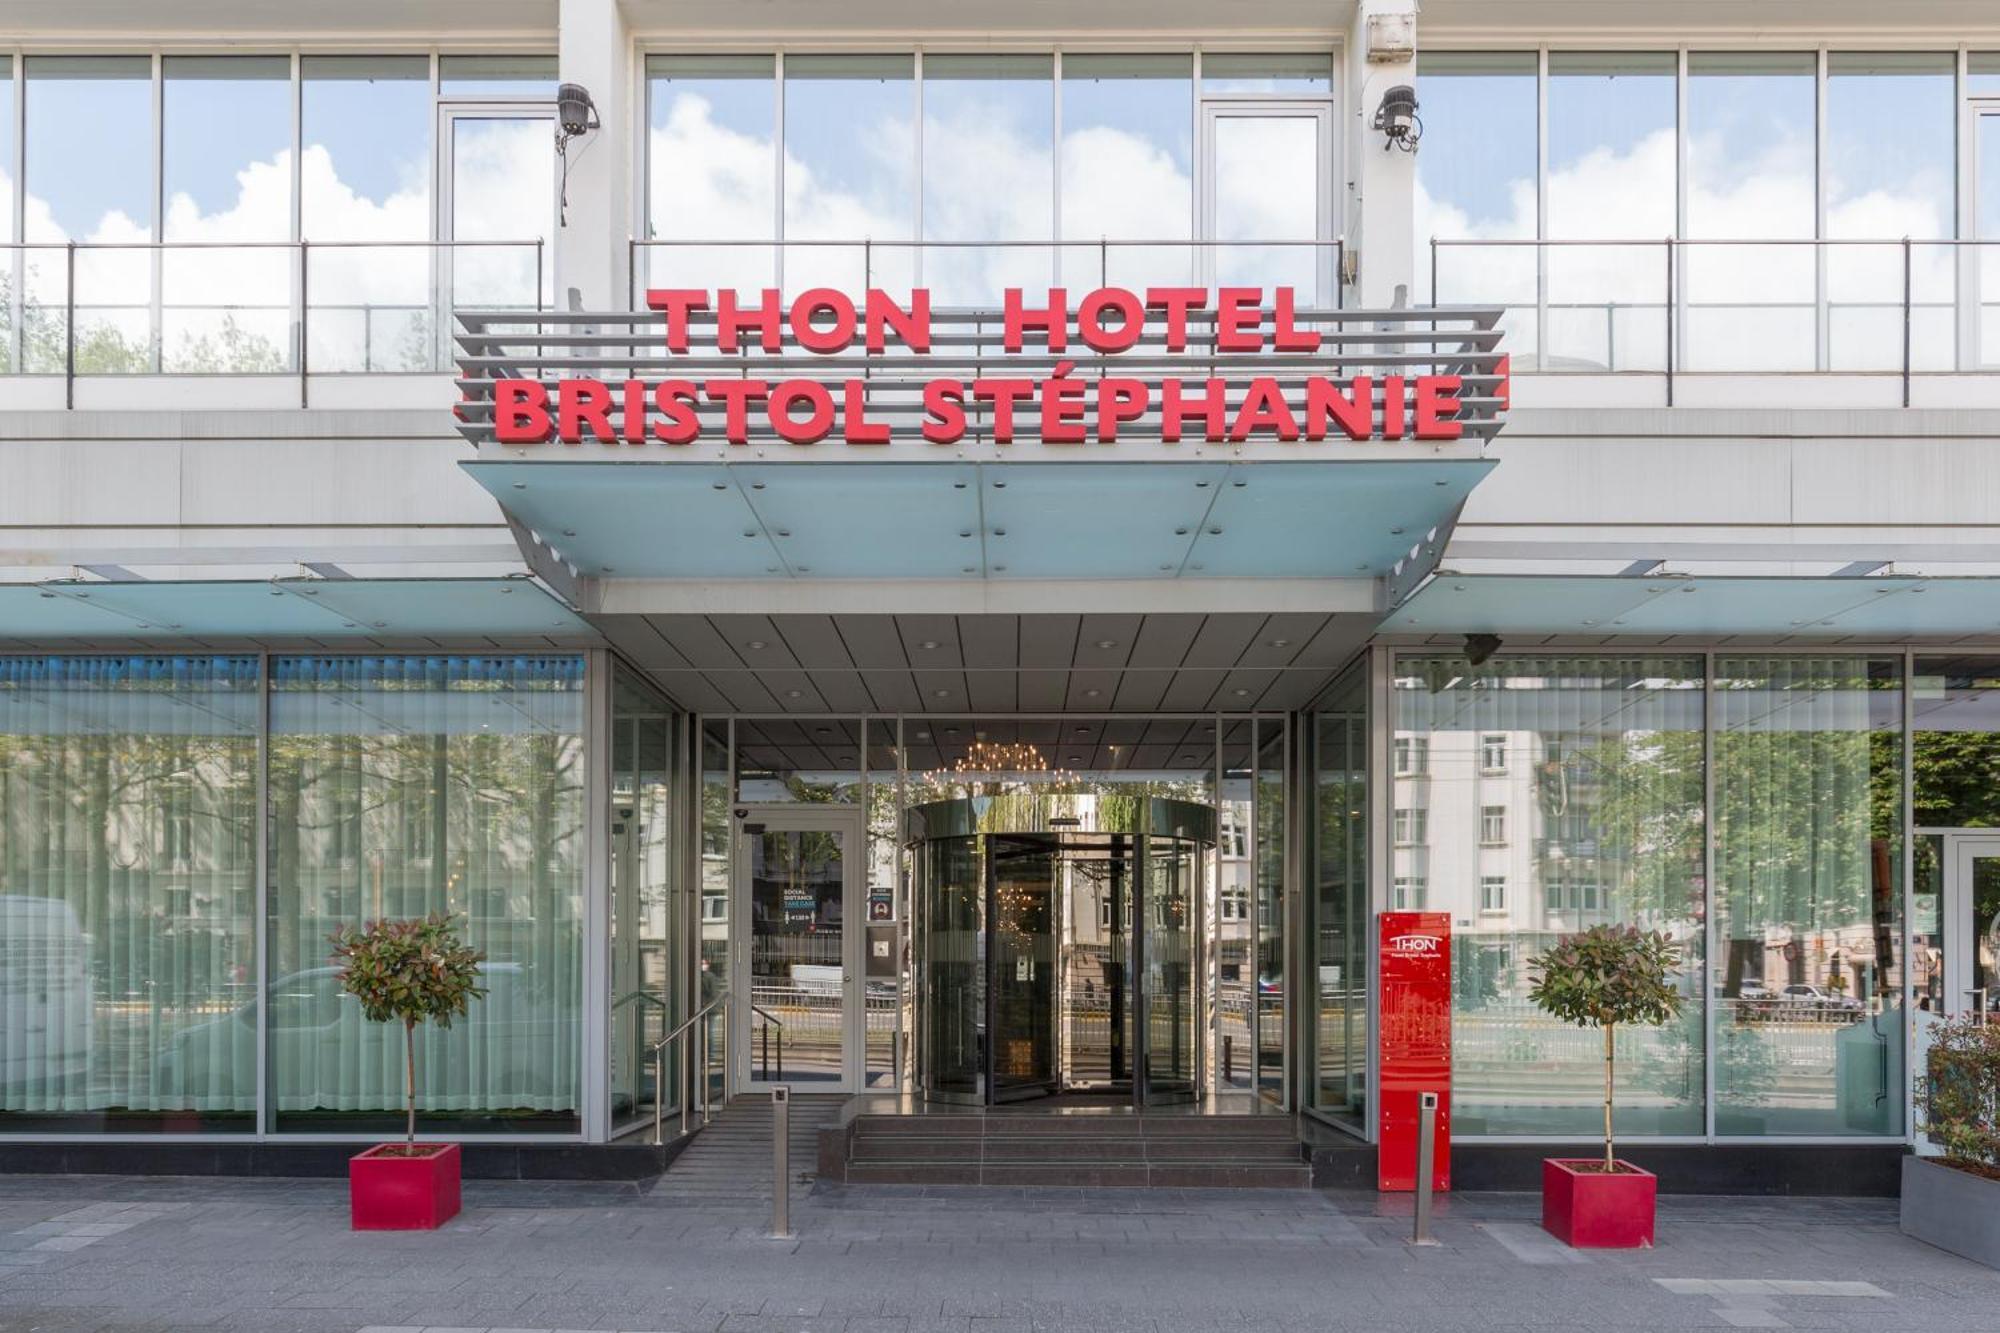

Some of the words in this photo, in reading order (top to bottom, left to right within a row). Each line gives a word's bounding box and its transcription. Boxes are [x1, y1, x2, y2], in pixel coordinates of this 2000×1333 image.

[646, 287, 930, 355] THON
[1003, 286, 1322, 354] HOTEL
[495, 378, 891, 445] BRISTOL
[922, 361, 1463, 444] STÉPHANIE
[1389, 935, 1443, 951] THON
